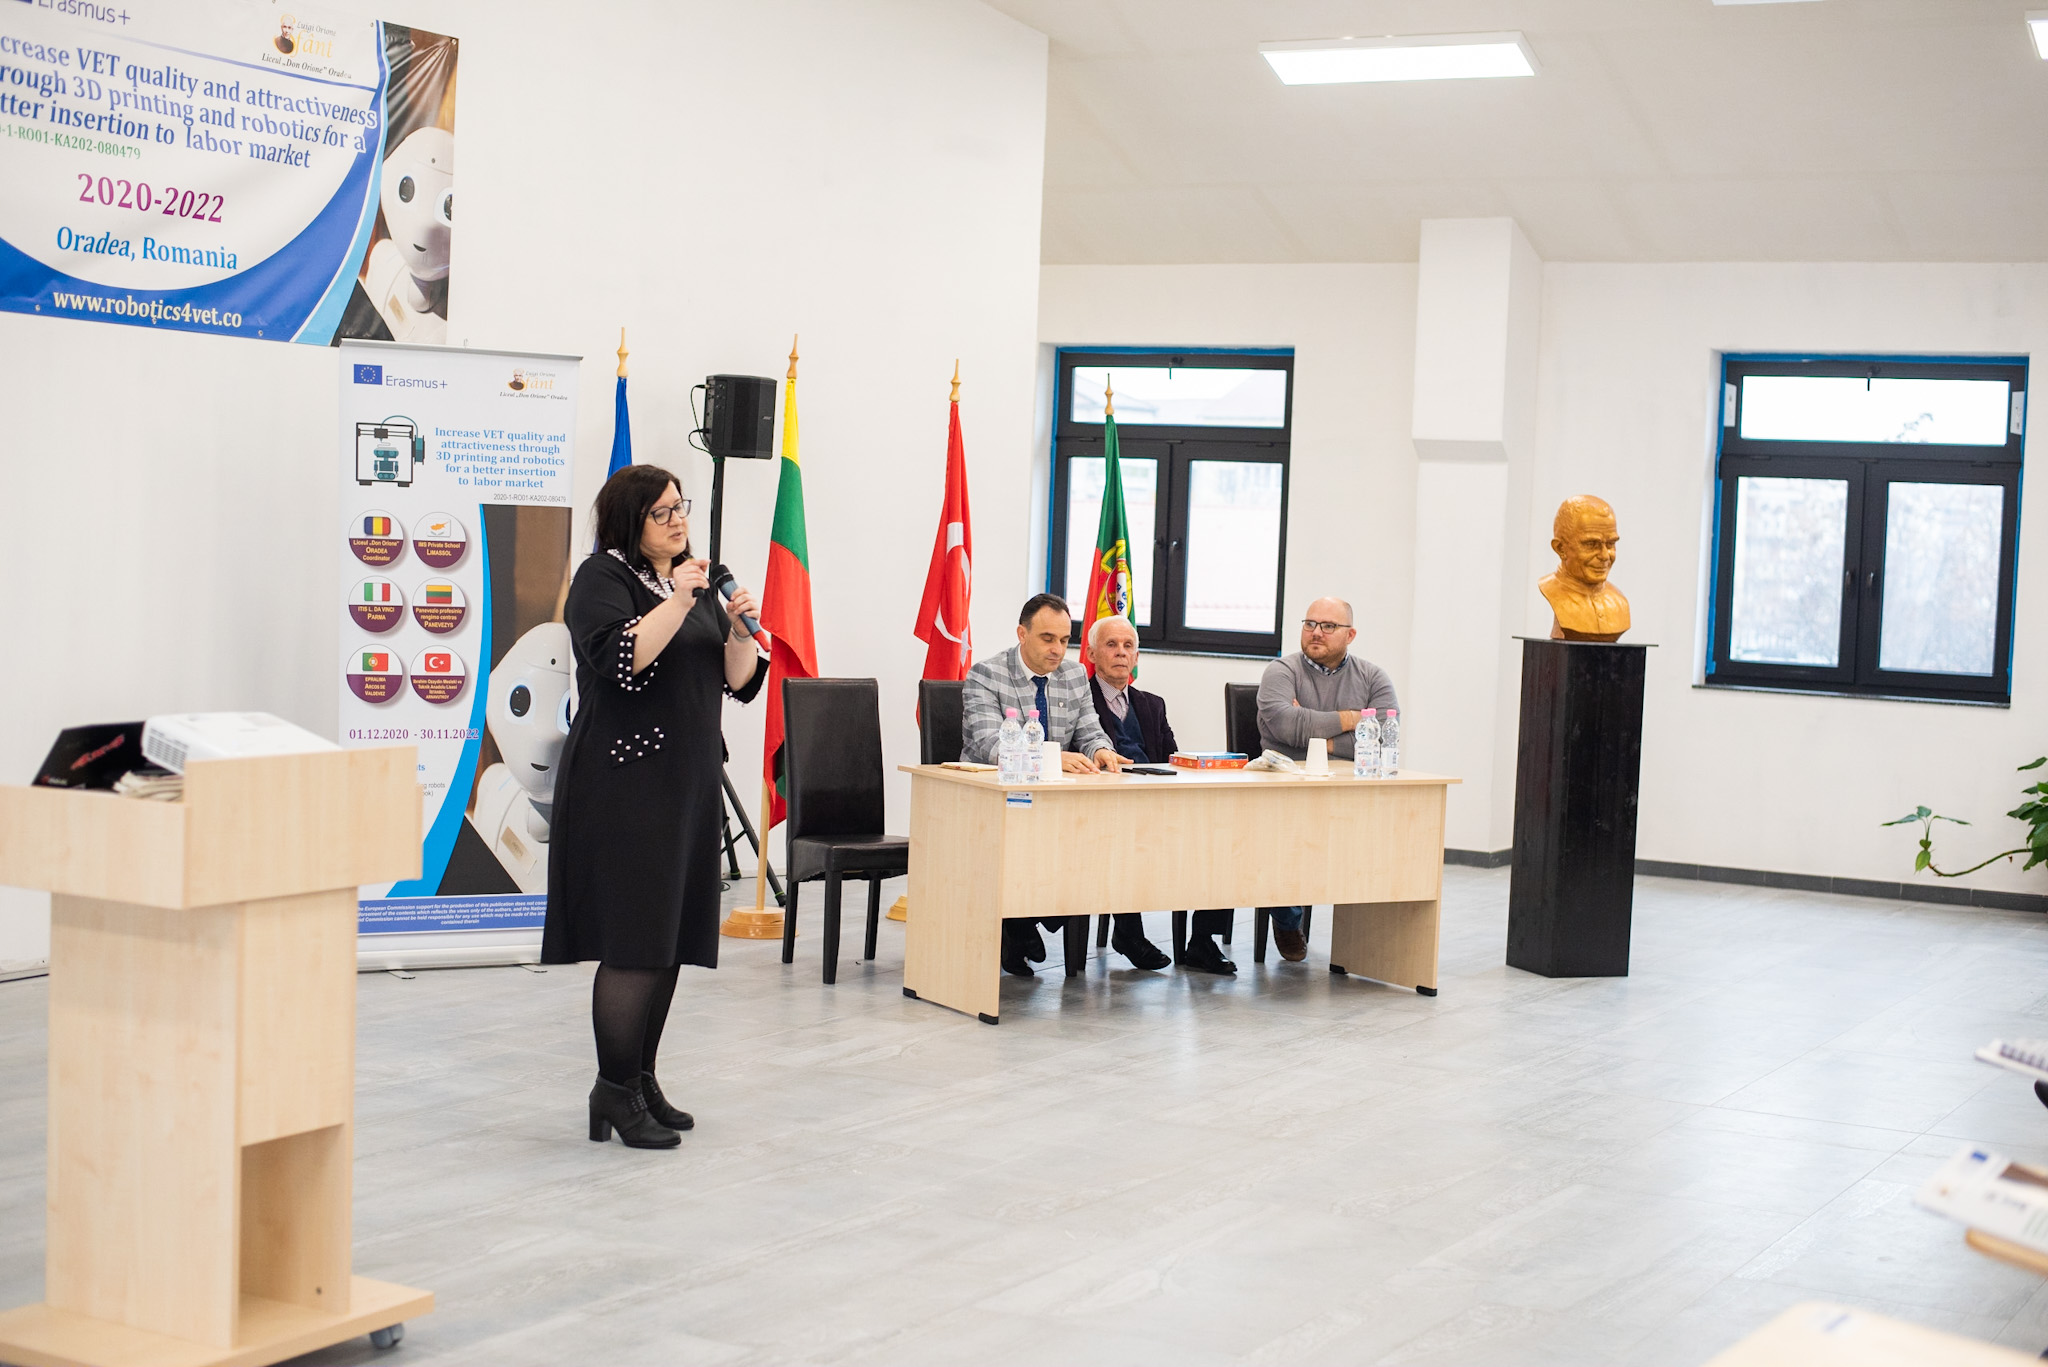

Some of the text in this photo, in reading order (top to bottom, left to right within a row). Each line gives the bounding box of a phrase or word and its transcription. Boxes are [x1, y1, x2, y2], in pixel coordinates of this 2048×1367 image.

[297, 21, 337, 37] Luigi Orione
[261, 53, 281, 65] Liceul
[76, 48, 120, 77] VET
[126, 64, 199, 98] quality
[204, 80, 240, 102] and
[246, 88, 377, 128] attractiveness
[73, 76, 102, 101] 3D
[109, 88, 194, 126] printing
[200, 106, 235, 129] and
[241, 114, 321, 143] robotics
[322, 124, 348, 148] for
[354, 137, 365, 151] a
[0, 124, 141, 159] -1-RO01-KA202-080479
[50, 100, 149, 140] insertion
[156, 123, 175, 145] to
[186, 125, 243, 155] labor
[249, 141, 312, 169] market
[78, 173, 224, 223] 2020-2022
[57, 226, 238, 270] Oradea, Romania
[53, 291, 242, 328] www.robotics4vet.co
[386, 375, 448, 389] Erasmus+
[435, 427, 566, 443] Increase VET quality and
[441, 440, 560, 455] attractiveness through
[436, 451, 565, 466] 3D printing and robotics
[445, 463, 556, 477] for a better insertion
[458, 476, 544, 488] to labor market
[349, 729, 409, 740] 01.12.2020
[420, 729, 479, 740] 30.11.2022
